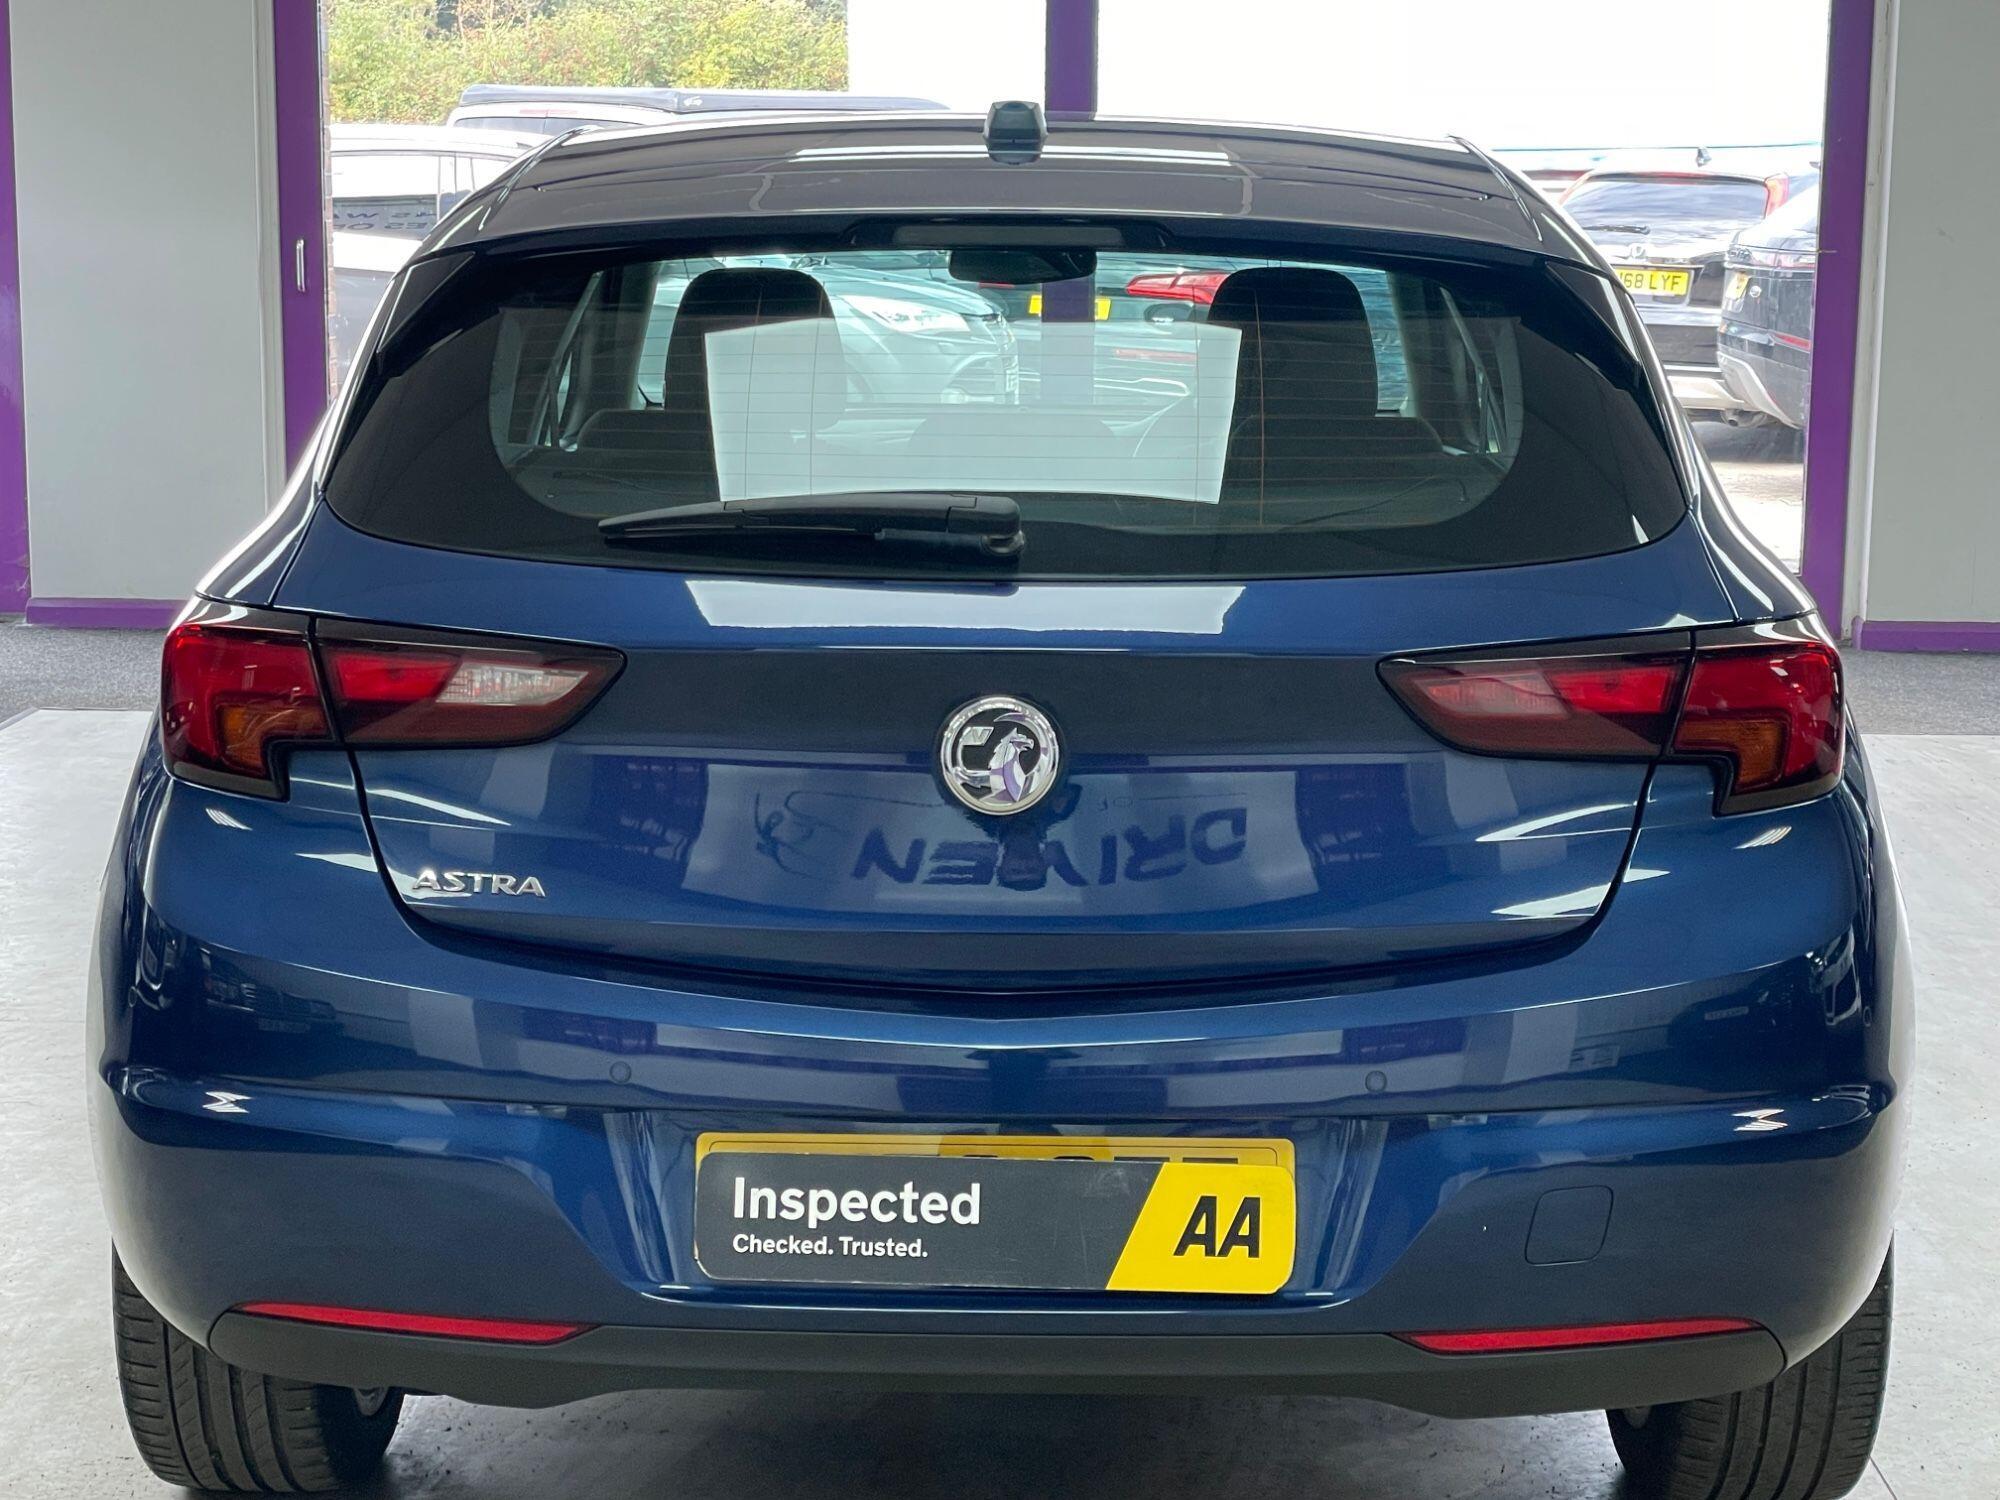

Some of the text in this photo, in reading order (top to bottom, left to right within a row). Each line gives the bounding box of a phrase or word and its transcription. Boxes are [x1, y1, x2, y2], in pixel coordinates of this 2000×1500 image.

[1620, 271, 1682, 291] 68 LYF
[412, 868, 546, 897] ASTRA
[734, 1177, 980, 1228] Inspected
[1173, 1195, 1260, 1258] AA
[733, 1234, 928, 1258] Checked. Trusted.
